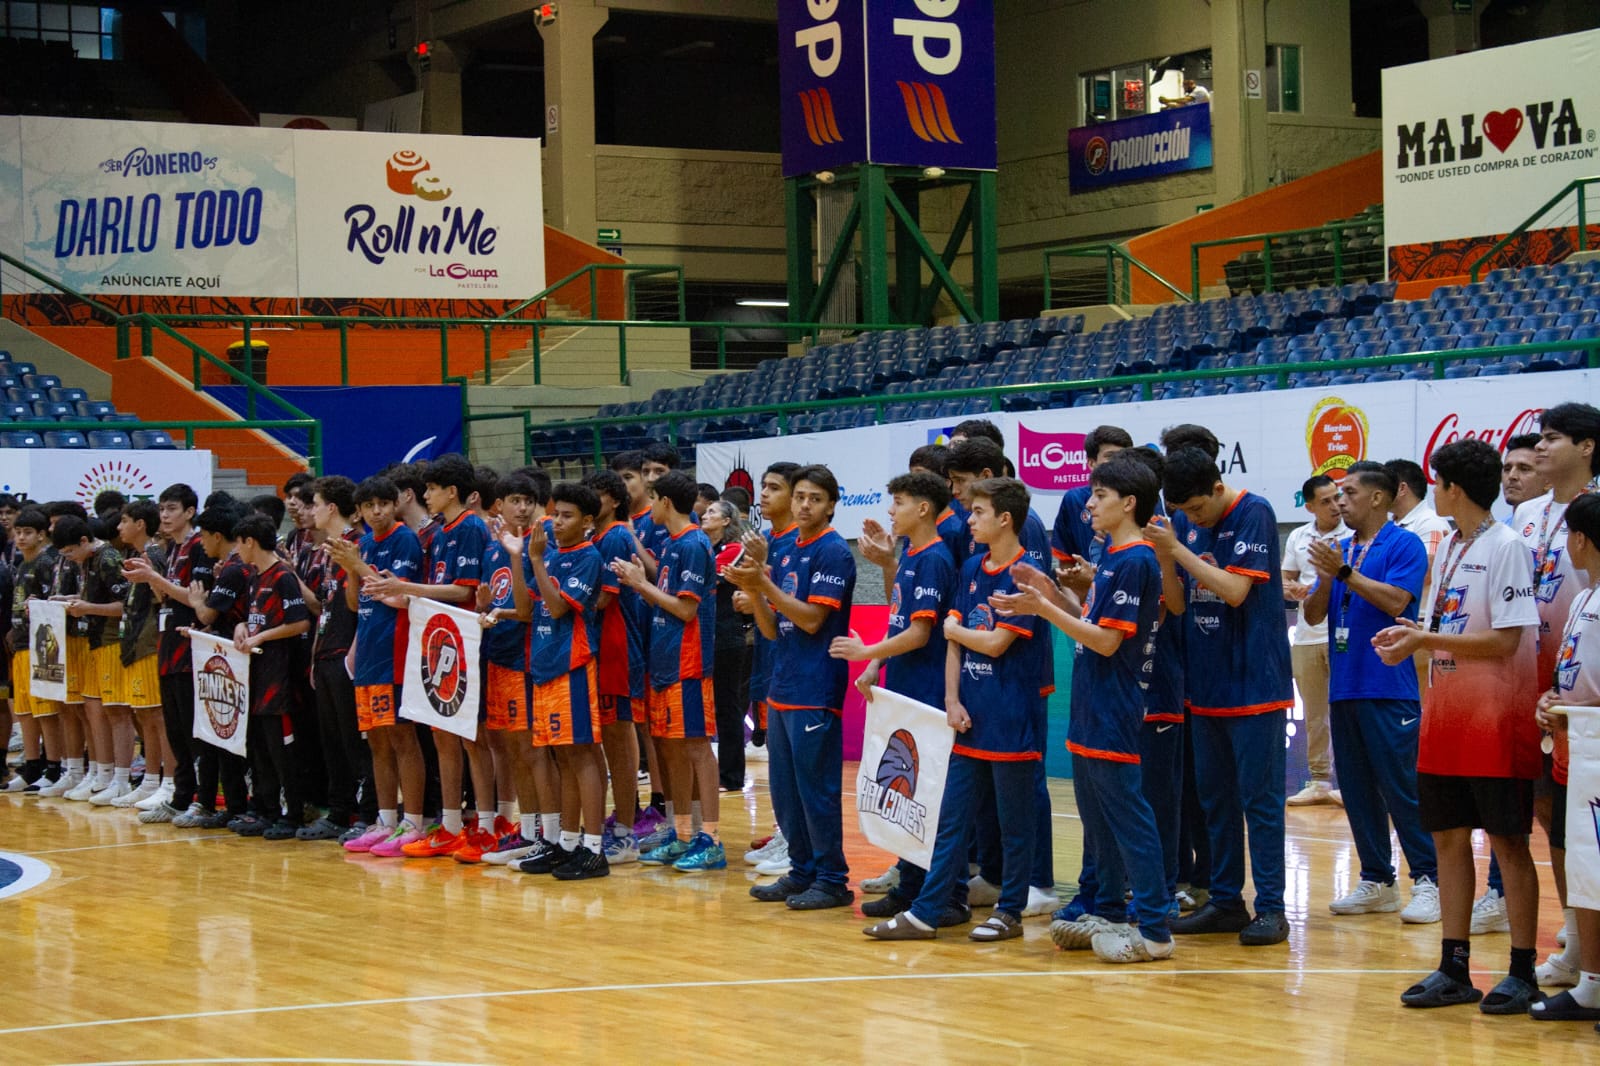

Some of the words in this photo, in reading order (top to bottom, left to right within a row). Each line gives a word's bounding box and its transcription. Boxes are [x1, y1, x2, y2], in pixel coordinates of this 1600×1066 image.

[1109, 122, 1190, 172] PRODUCCIÓN
[122, 147, 203, 178] PIONERO
[1437, 165, 1471, 178] USTED
[1474, 159, 1519, 174] COMPRA
[1522, 155, 1537, 167] DE
[54, 192, 161, 259] DARLO
[174, 186, 264, 250] TODO
[344, 203, 415, 265] Roll
[101, 273, 182, 288] ANÚNCIATE
[186, 274, 220, 290] AQUÍ
[430, 264, 445, 278] La
[446, 262, 499, 282] Guapa
[1332, 432, 1344, 441] de
[1022, 447, 1041, 467] La
[372, 694, 391, 713] 23
[508, 699, 517, 718] 6
[550, 712, 561, 732] 5
